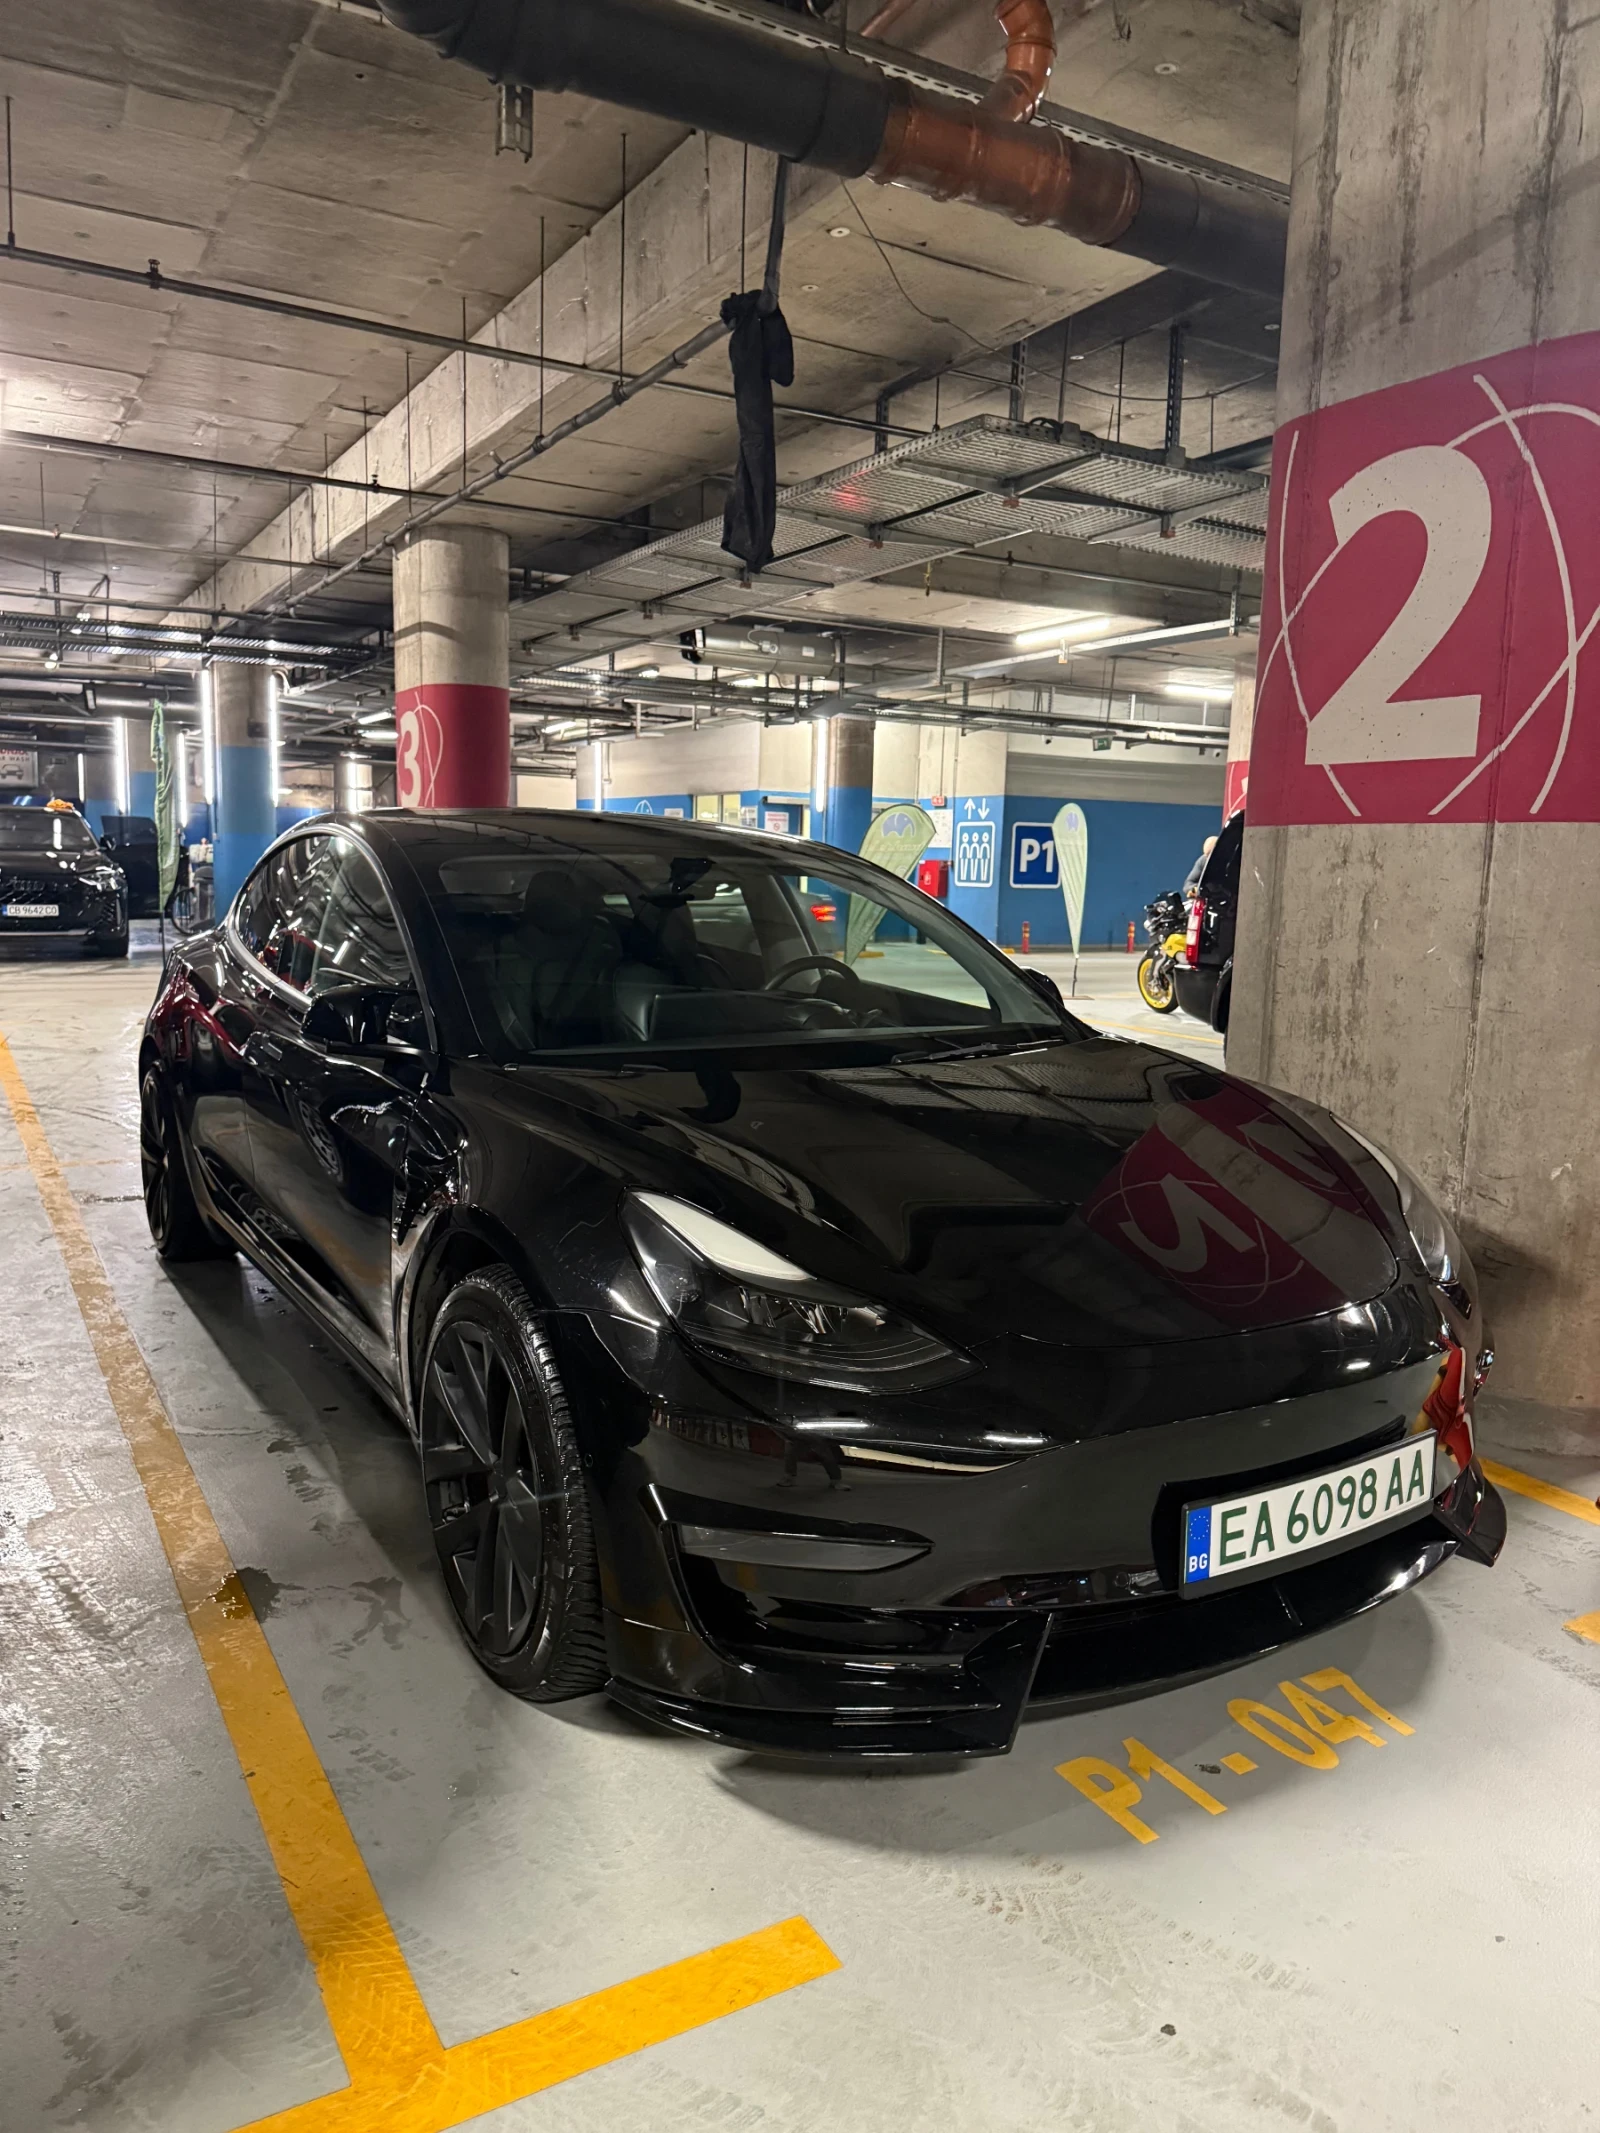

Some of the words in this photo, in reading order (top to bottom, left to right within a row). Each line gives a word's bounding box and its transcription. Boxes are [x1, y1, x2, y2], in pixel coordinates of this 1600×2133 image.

[1305, 444, 1492, 765] 2
[400, 710, 421, 808] 3
[1019, 838, 1054, 873] P1
[1219, 1500, 1275, 1566] EA
[1286, 1467, 1378, 1544] 6098
[1384, 1449, 1425, 1512] AA
[1188, 1553, 1208, 1573] BG
